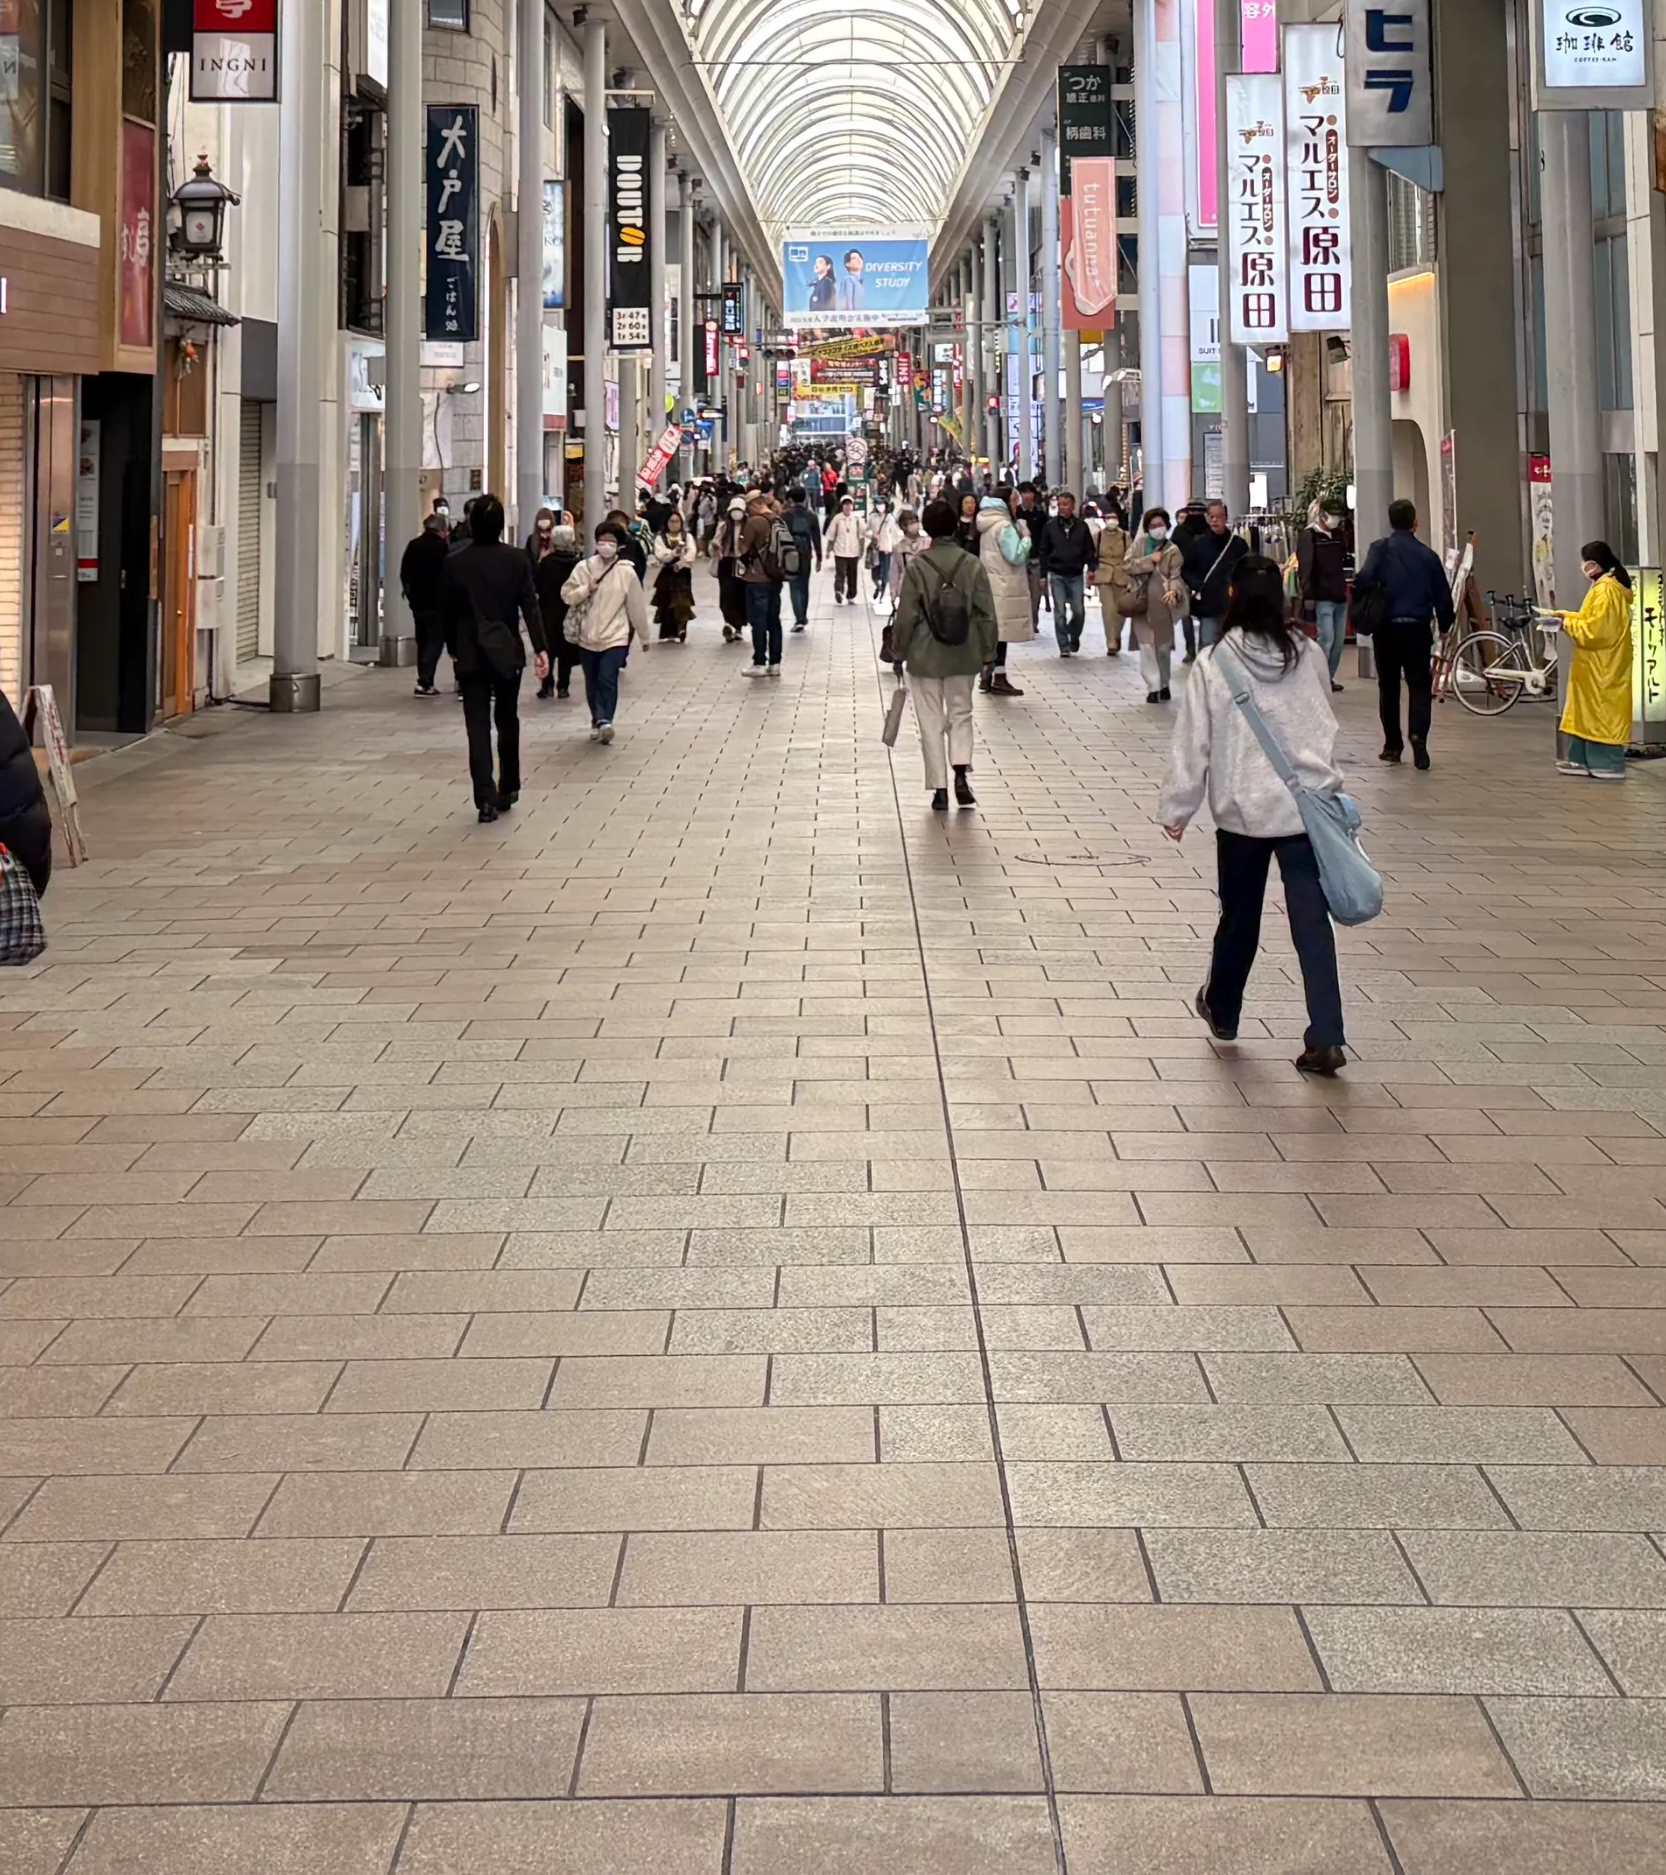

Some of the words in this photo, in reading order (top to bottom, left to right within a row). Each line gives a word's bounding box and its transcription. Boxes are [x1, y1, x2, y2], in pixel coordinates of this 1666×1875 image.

[1555, 29, 1634, 55] 珈琲館
[199, 55, 269, 74] INGNI
[435, 114, 470, 262] 大戸屋
[1299, 115, 1342, 313] マルエス原田
[1239, 154, 1276, 329] マルエス原田
[865, 261, 923, 273] DIVERSITY
[875, 277, 911, 288] STUDY
